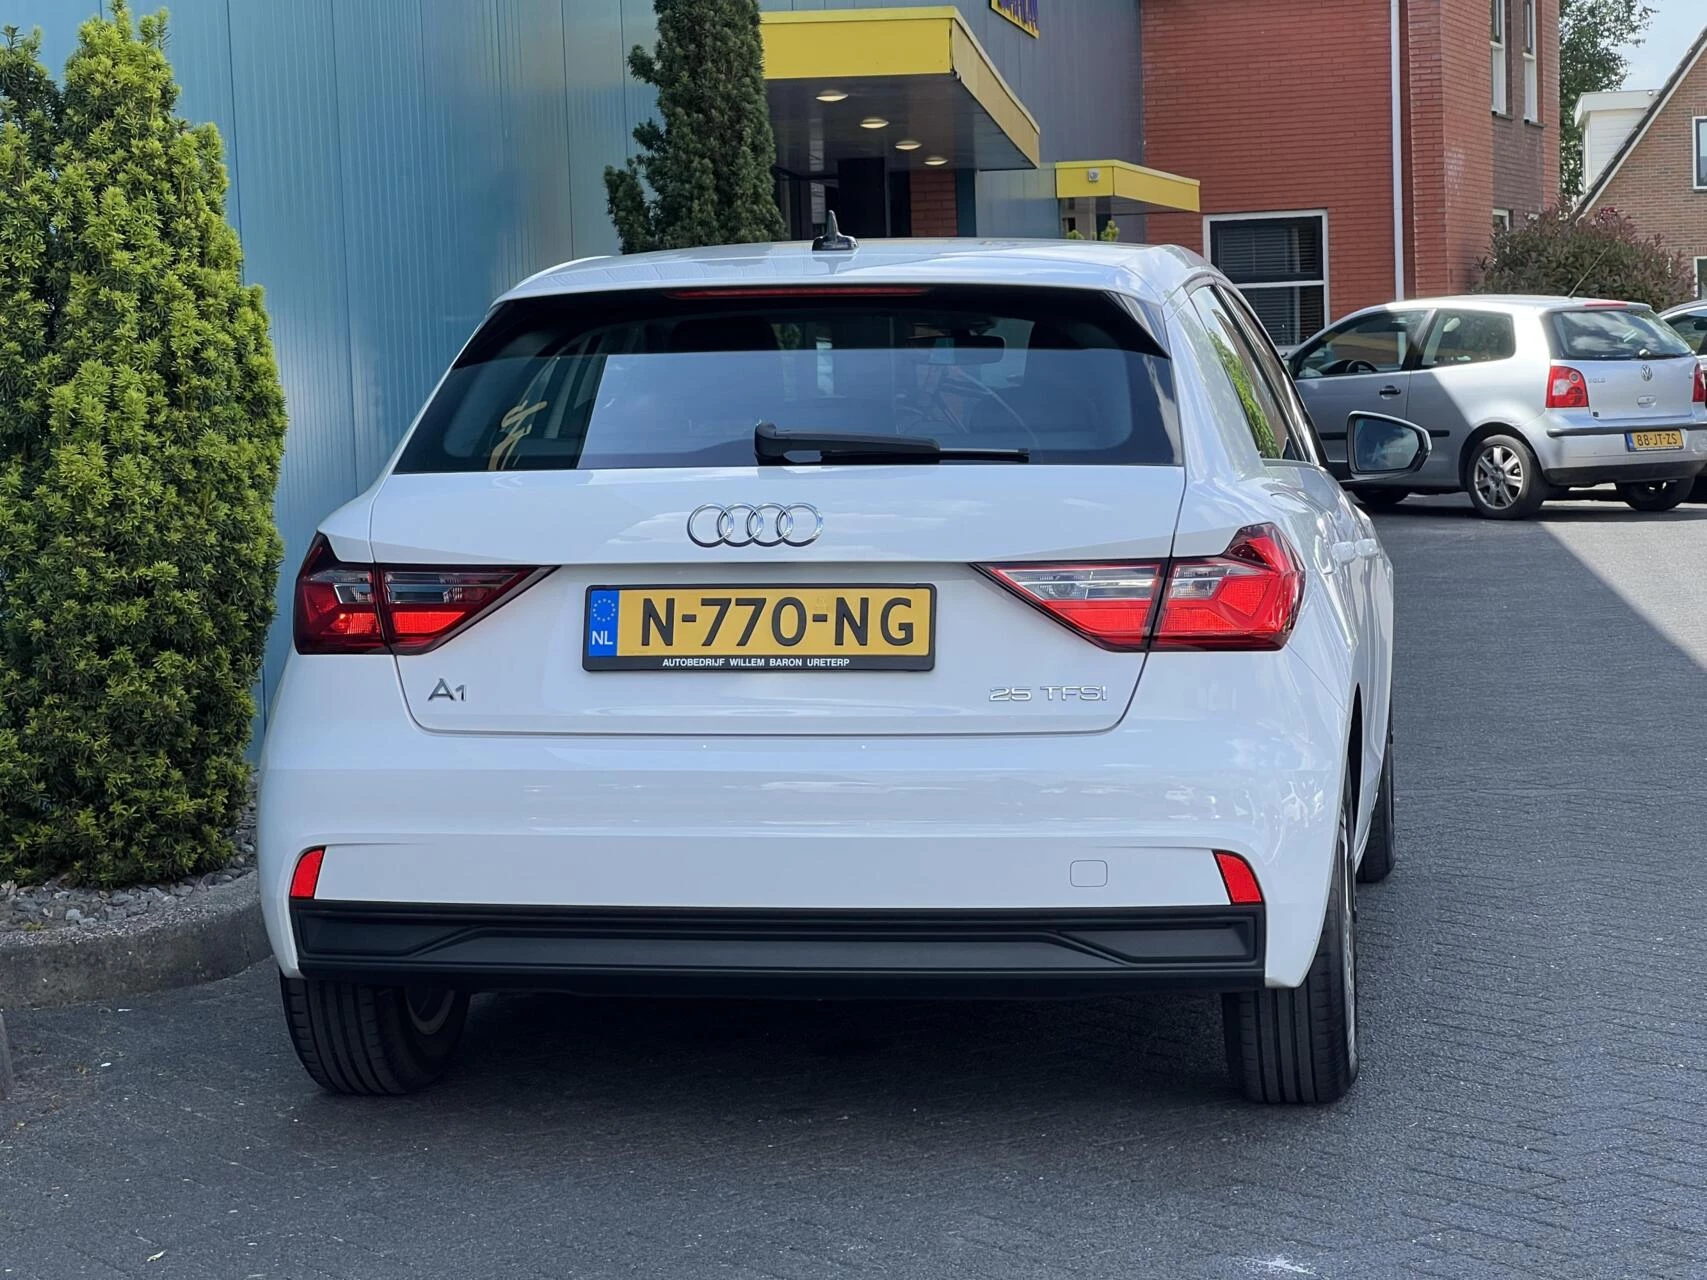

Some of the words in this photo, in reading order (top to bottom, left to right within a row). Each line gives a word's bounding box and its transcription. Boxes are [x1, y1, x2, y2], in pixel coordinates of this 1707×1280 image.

[1636, 432, 1678, 447] 88-JT-ZS
[641, 596, 915, 647] N-770-NG
[591, 630, 614, 645] NL
[662, 658, 726, 667] AUTOBEDRIJF
[729, 658, 765, 667] WILLEM
[769, 658, 803, 667] BARON
[807, 658, 850, 667] URETERP
[427, 677, 466, 701] A1
[989, 686, 1032, 701] 25
[1040, 685, 1108, 701] TFSI
